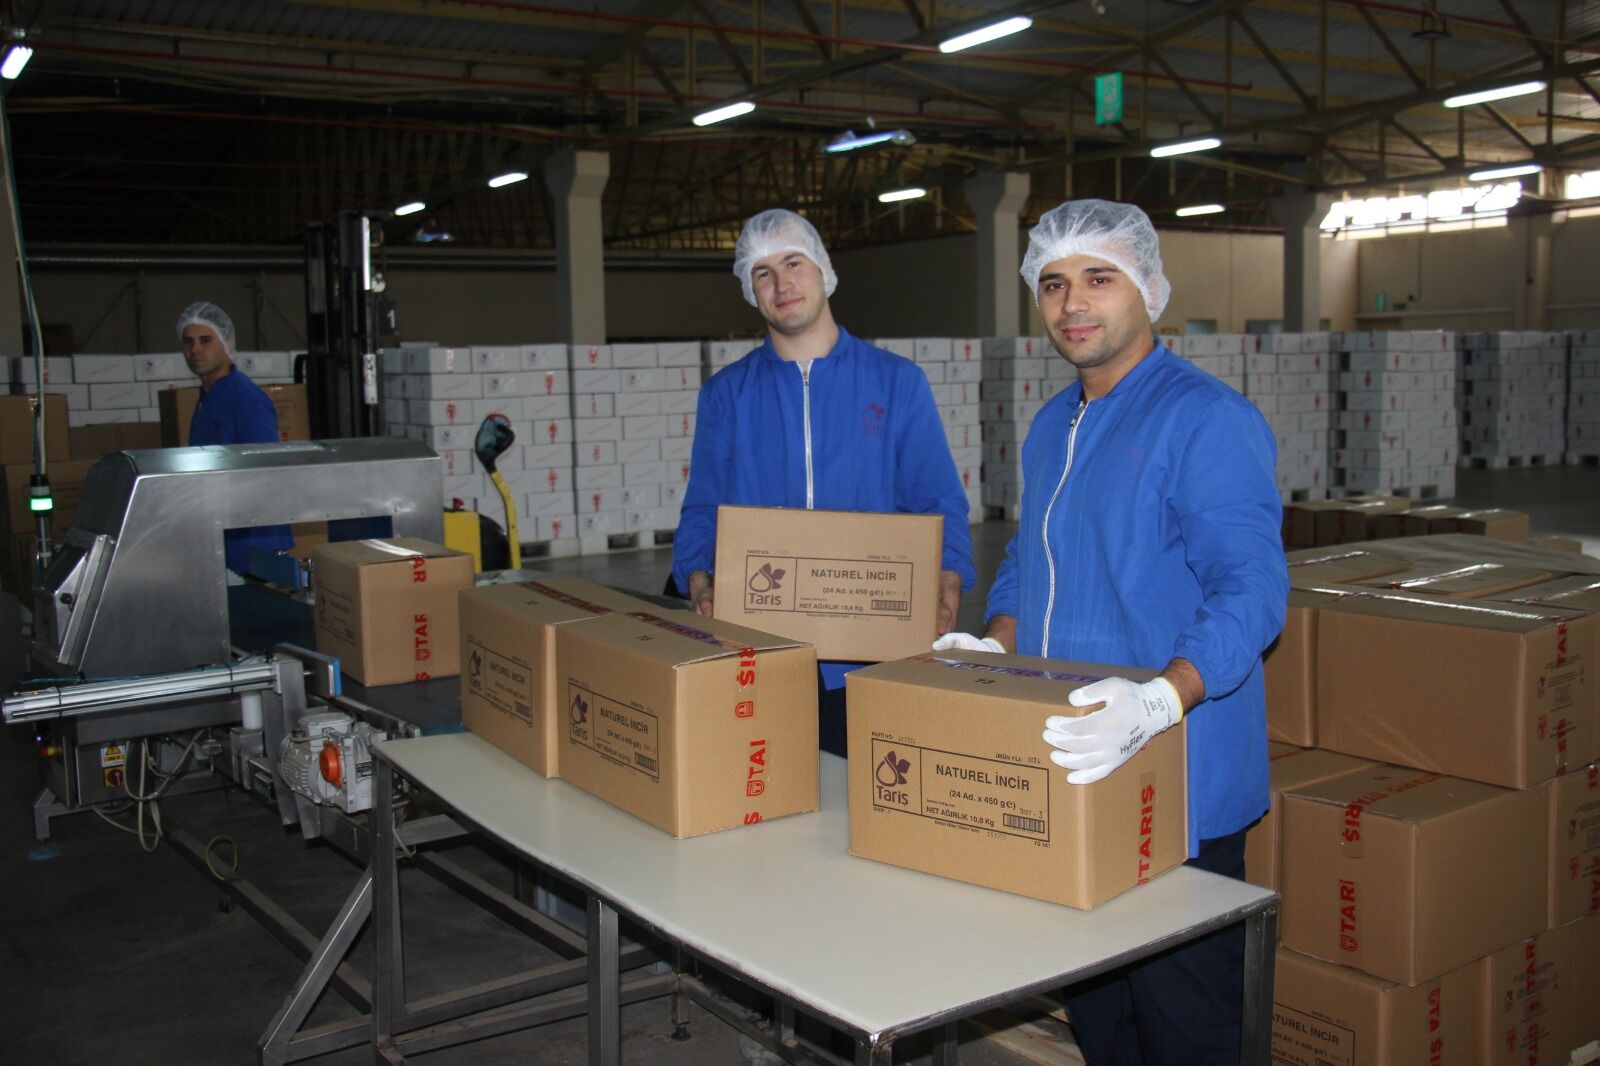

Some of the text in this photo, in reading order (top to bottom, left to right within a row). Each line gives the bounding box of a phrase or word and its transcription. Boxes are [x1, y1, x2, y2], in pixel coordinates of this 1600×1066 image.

[387, 309, 395, 328] 1
[811, 568, 896, 581] NATUREL İNCİR
[600, 706, 630, 728] NATUREL
[630, 719, 649, 735] İNCİR
[1120, 734, 1144, 755] HyFlex
[936, 764, 1030, 792] NATUREL İNCİR
[949, 789, 961, 799] (24
[963, 792, 976, 802] Ad.
[984, 797, 999, 807] 450
[926, 806, 940, 816] NET
[941, 806, 968, 821] AĞIRLIK
[970, 815, 984, 825] 10,8
[985, 817, 995, 828] Kg
[1310, 1024, 1339, 1046] İNCİR
